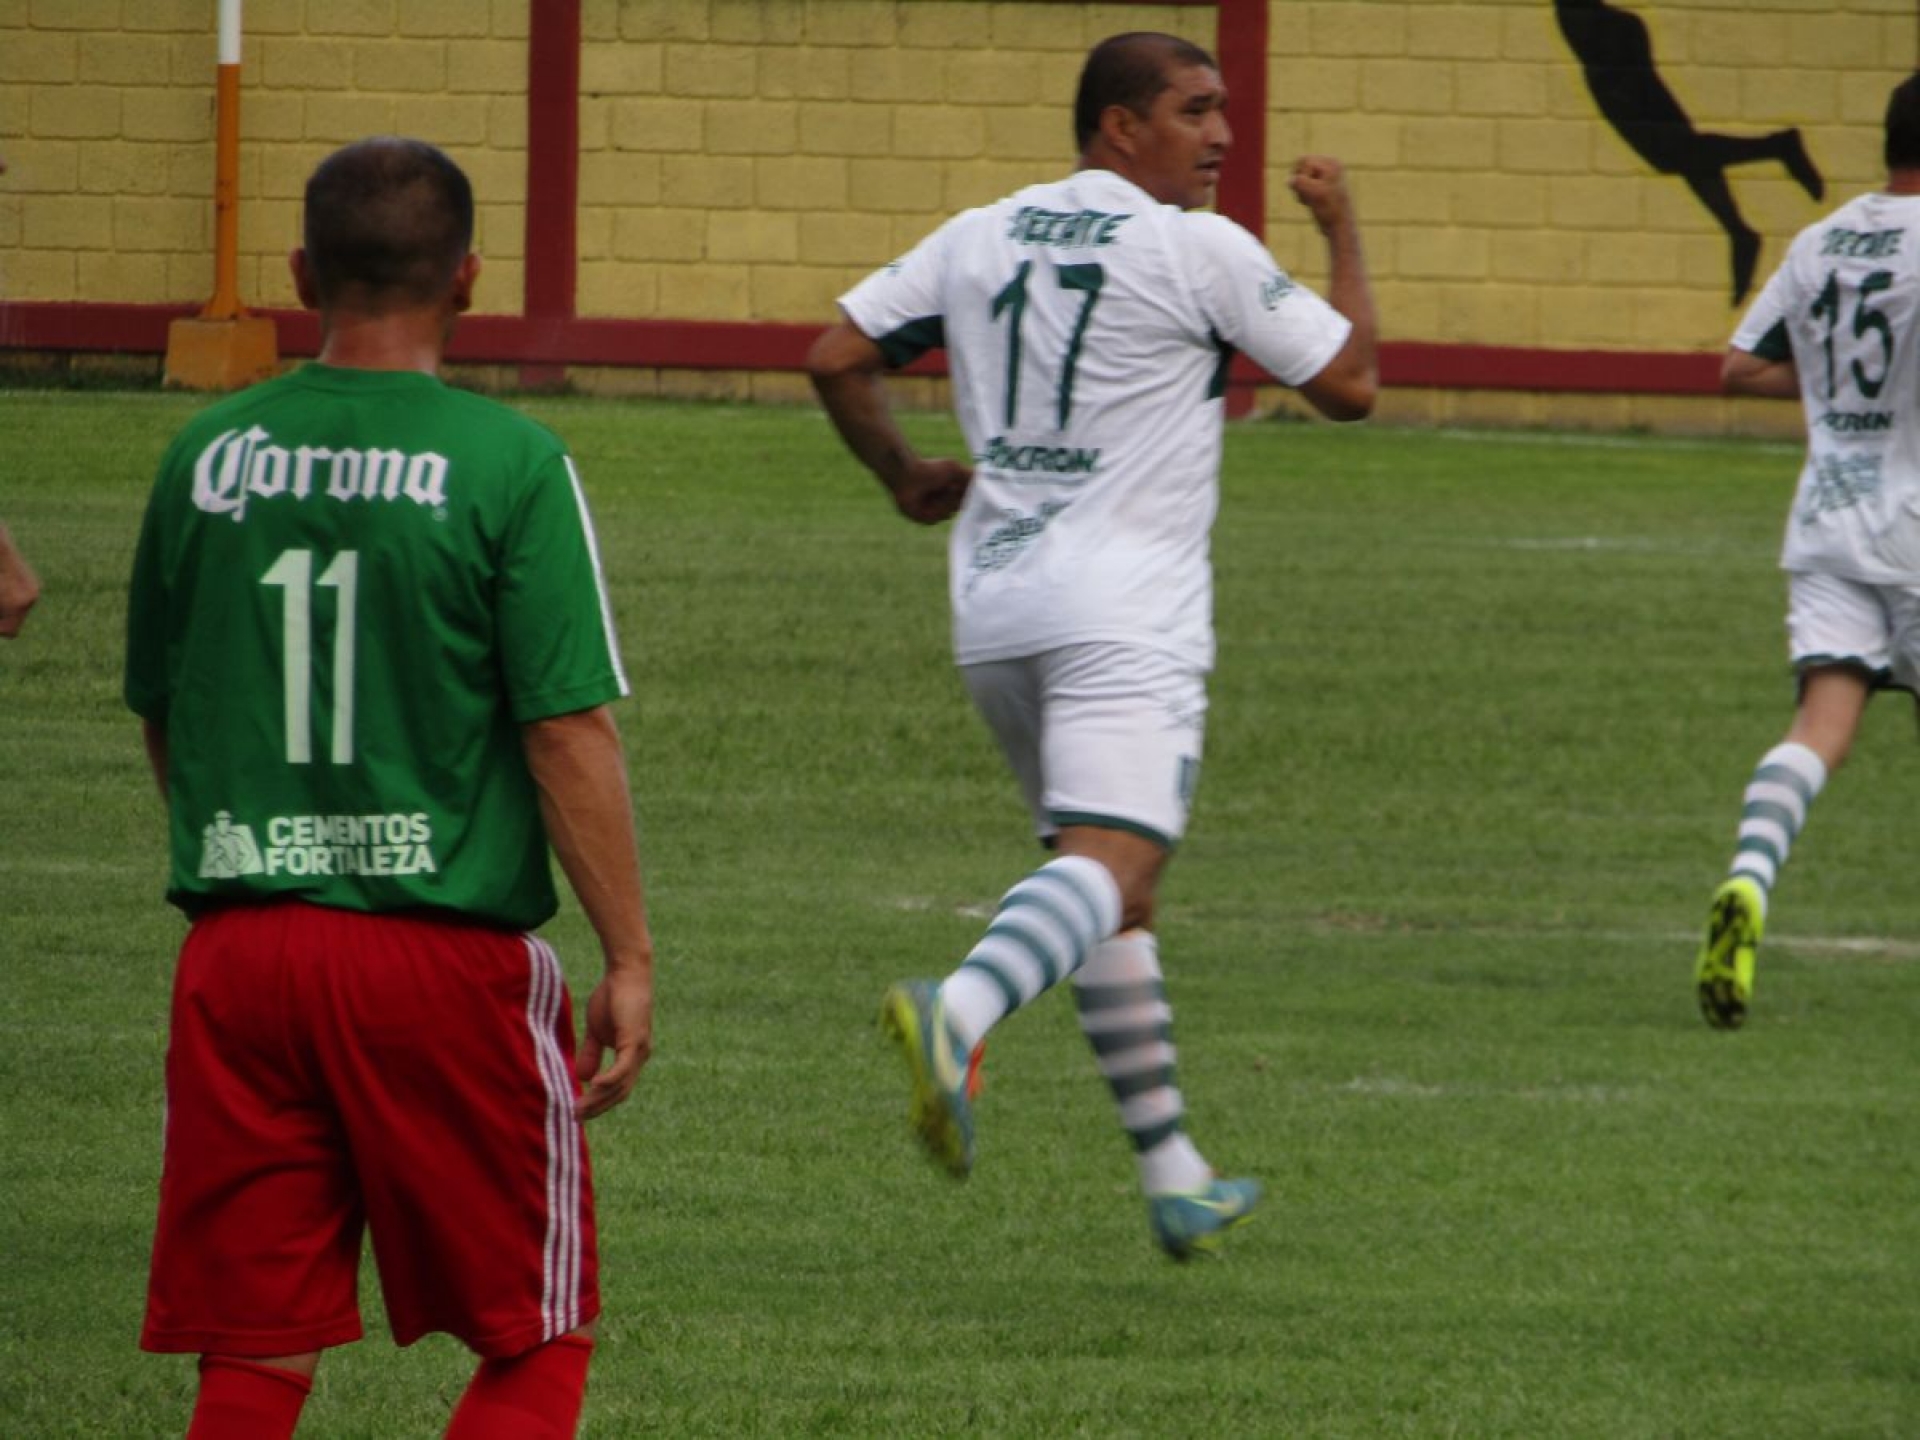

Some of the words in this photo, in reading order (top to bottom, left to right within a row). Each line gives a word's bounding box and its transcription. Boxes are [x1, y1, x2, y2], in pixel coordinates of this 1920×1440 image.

[991, 259, 1105, 430] 17
[1811, 268, 1894, 399] 15
[192, 425, 449, 522] Corona
[259, 549, 359, 764] 11
[264, 845, 437, 876] FORTALEZA
[267, 813, 431, 845] CEMENTOS
